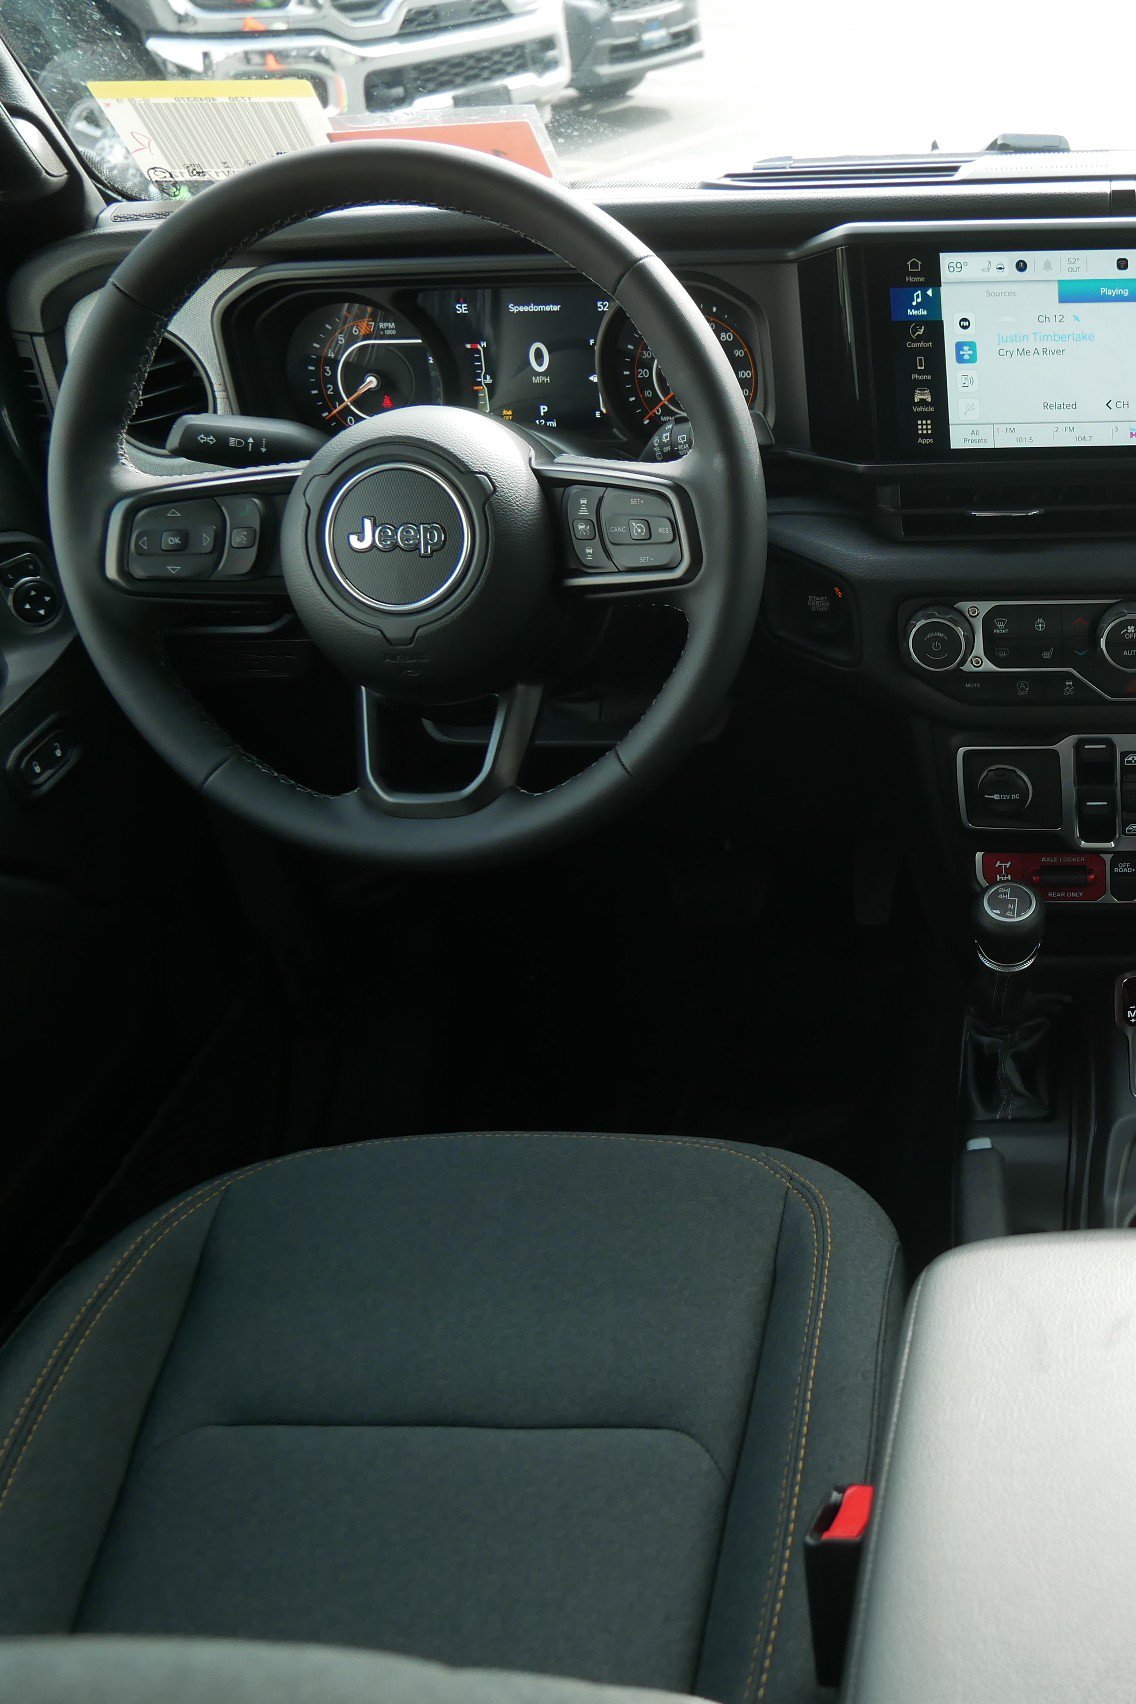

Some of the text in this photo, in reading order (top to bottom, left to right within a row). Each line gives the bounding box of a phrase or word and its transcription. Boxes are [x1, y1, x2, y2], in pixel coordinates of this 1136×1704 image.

[905, 275, 925, 283] Home
[985, 290, 1016, 298] Sources
[1100, 287, 1129, 297] Playing
[455, 304, 469, 314] SE
[508, 303, 561, 313] Speedometer
[907, 308, 928, 316] Media
[1037, 314, 1065, 323] Ch 12
[352, 325, 359, 335] 6
[368, 321, 375, 332] 7
[379, 322, 395, 330] RPM
[338, 334, 345, 344] 5
[720, 332, 733, 342] 80
[997, 330, 1095, 345] Justin Timberlake
[327, 350, 335, 360] 4
[528, 341, 550, 373] 0
[733, 350, 745, 358] 90
[998, 347, 1065, 358] Cry Me A River
[324, 367, 332, 376] 3
[637, 368, 650, 378] 20
[738, 370, 752, 378] 100
[532, 376, 550, 384] MPH
[911, 373, 932, 381] Phone
[326, 385, 334, 395] 2
[1043, 401, 1077, 410] Related
[1115, 400, 1130, 409] CH
[540, 405, 548, 416] P
[347, 416, 355, 426] 0
[917, 437, 934, 445] Apps
[168, 535, 181, 545] OK
[348, 515, 448, 558] Jeep
